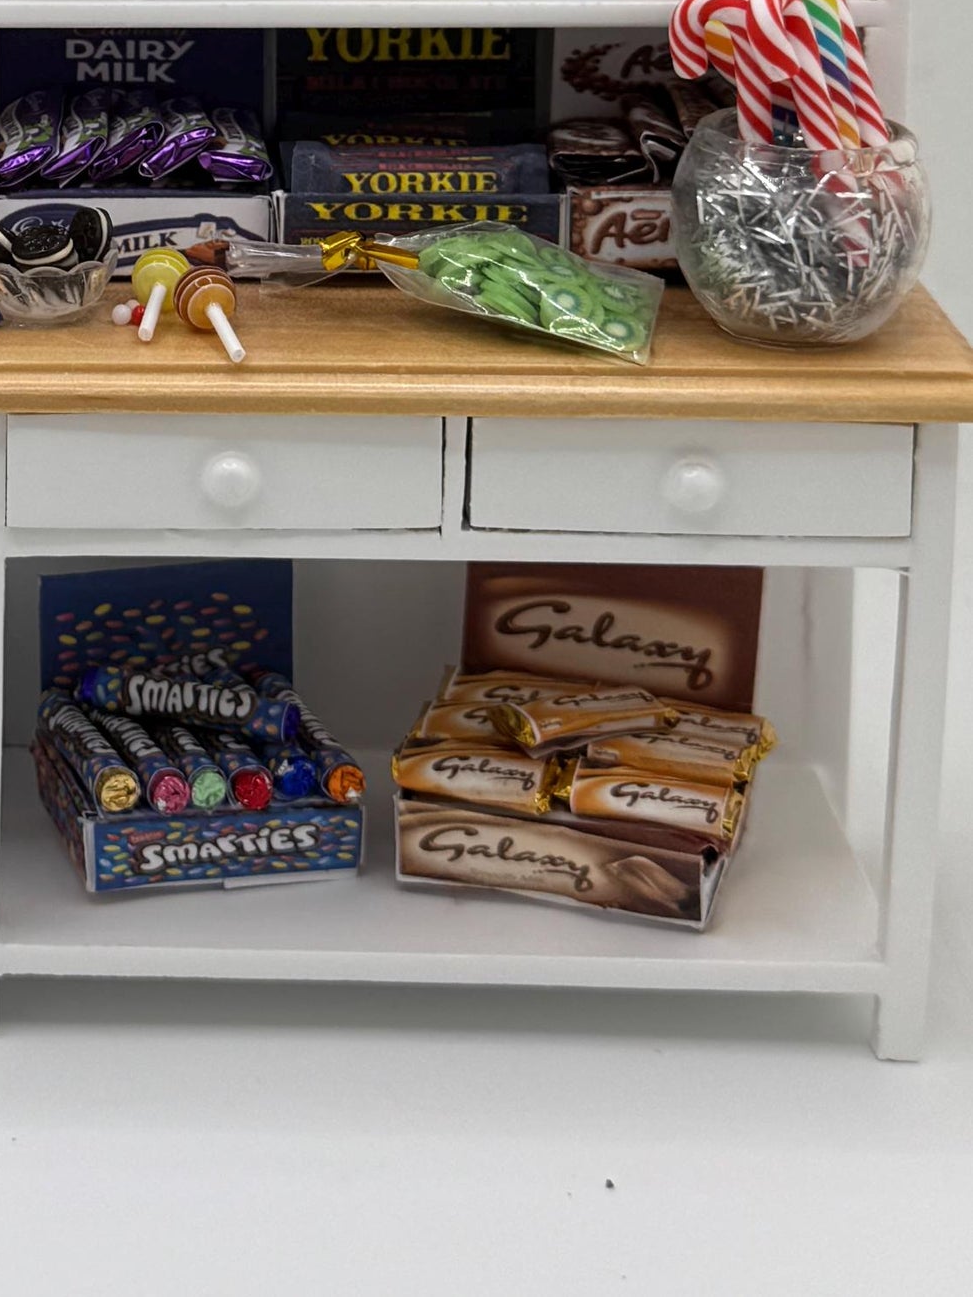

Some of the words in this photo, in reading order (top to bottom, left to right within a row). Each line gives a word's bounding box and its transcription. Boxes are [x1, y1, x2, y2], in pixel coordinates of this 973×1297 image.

[64, 38, 196, 62] DAIRY
[306, 28, 512, 64] YORKIE
[75, 61, 178, 84] MILK
[341, 170, 500, 195] YORKIE
[306, 201, 529, 223] YORKIE
[494, 599, 715, 691] Galaxy
[125, 673, 253, 719] SMARTIES
[431, 756, 535, 792] Galaxy
[610, 781, 718, 823] Galaxy
[137, 823, 319, 872] SMARTIES
[418, 824, 594, 892] Galaxy
